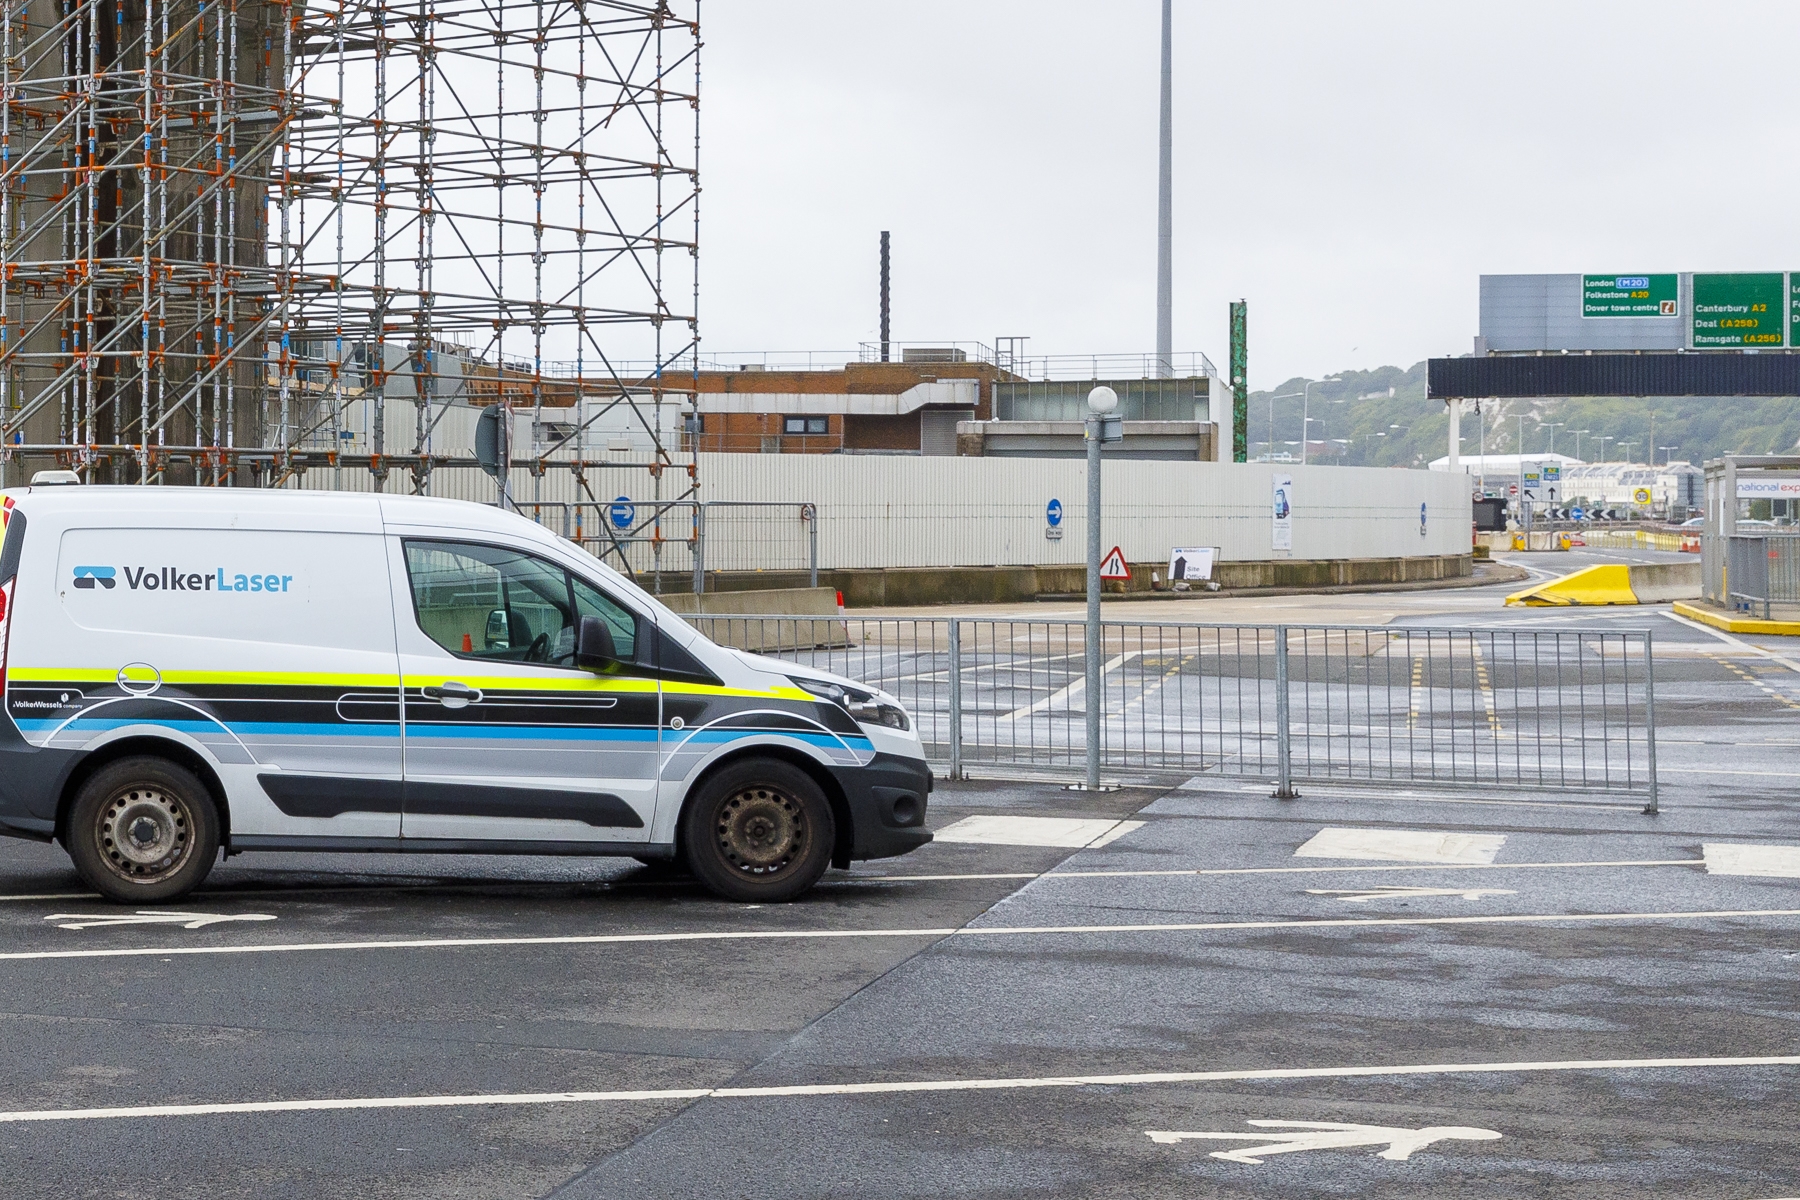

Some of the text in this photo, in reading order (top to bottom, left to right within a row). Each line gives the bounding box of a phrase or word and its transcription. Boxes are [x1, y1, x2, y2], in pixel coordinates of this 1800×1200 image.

[1617, 279, 1647, 287] (M20)
[1696, 304, 1766, 313] Canterbury A2
[1695, 335, 1741, 344] Ramsgate
[1737, 483, 1779, 491] national
[123, 566, 293, 592] VolkerLaser
